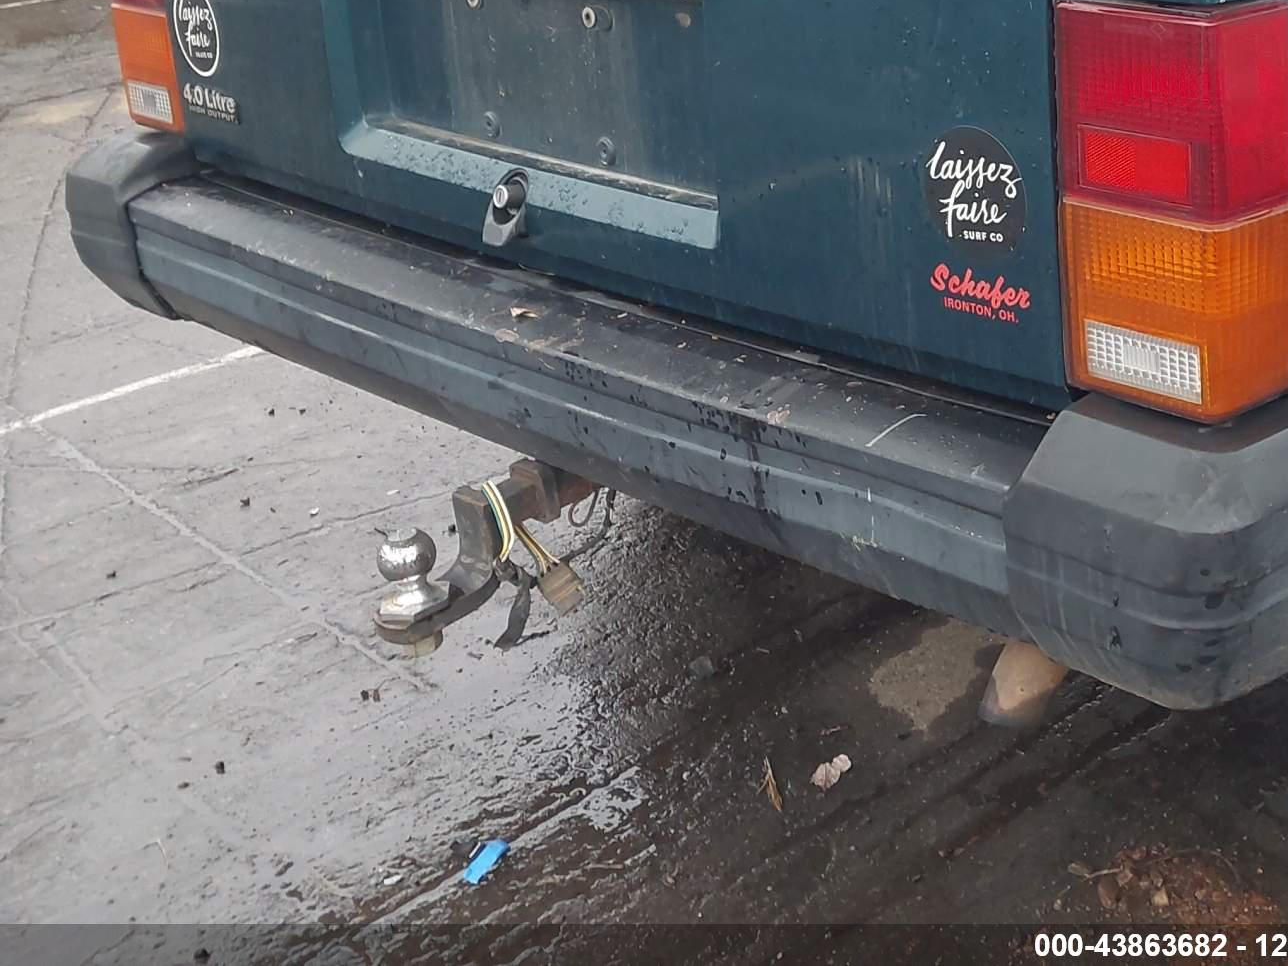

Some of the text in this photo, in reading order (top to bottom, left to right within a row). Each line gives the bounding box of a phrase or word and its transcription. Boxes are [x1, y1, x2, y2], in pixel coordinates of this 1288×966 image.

[183, 82, 236, 114] 4.0 Litre
[925, 141, 1023, 199] laissez
[938, 179, 1008, 238] faire
[963, 229, 1004, 243] SURF CO
[930, 262, 1031, 309] Schafer
